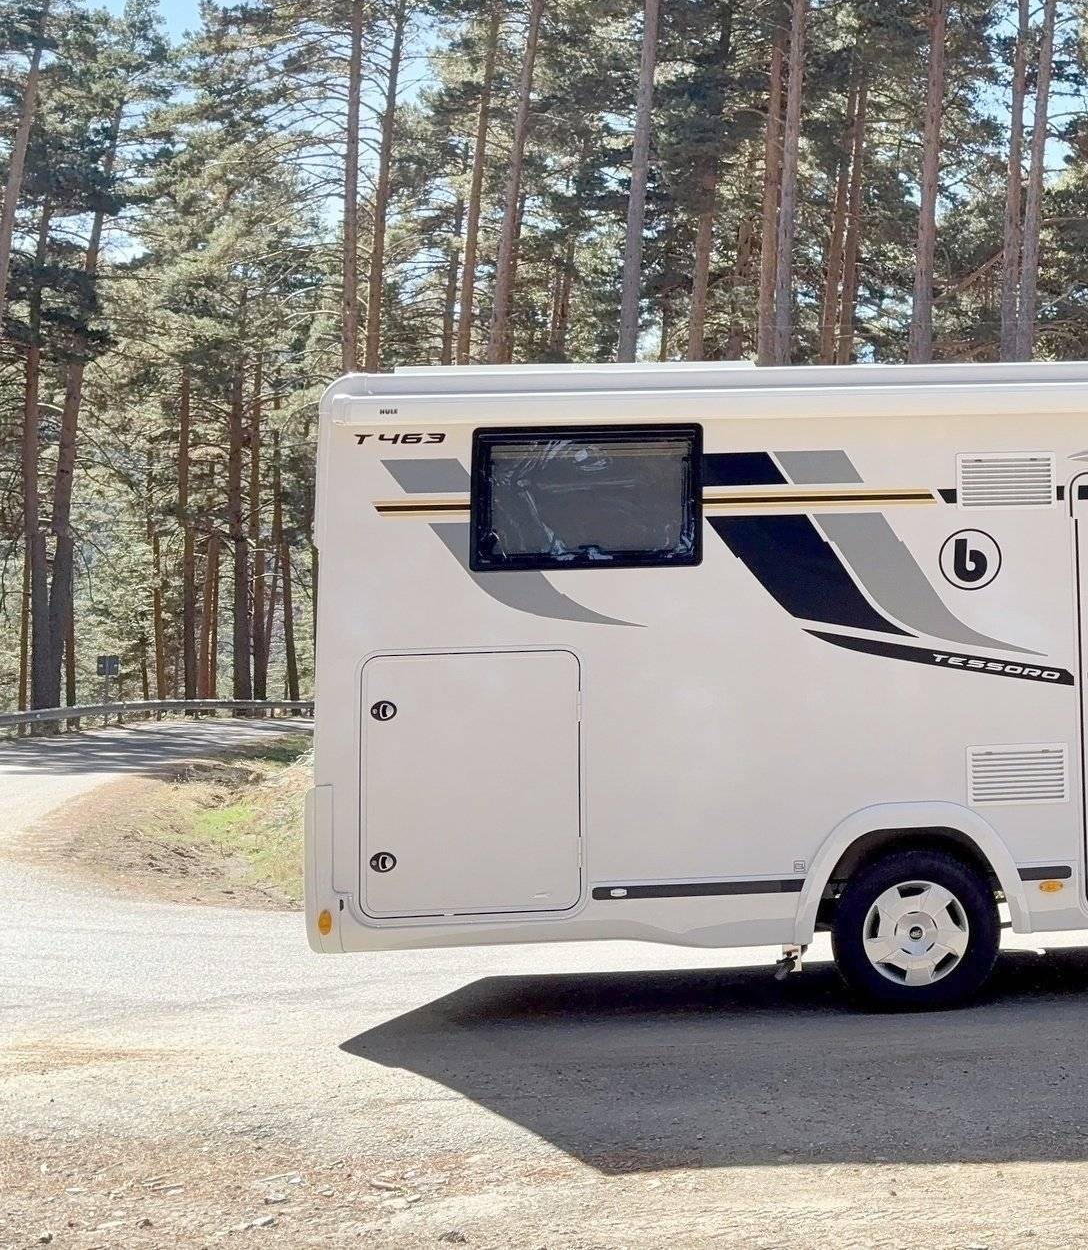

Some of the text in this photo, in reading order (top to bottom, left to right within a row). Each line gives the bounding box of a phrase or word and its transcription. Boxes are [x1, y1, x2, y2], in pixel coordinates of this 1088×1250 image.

[354, 433, 446, 445] T 463
[932, 653, 1061, 680] TESSORO
